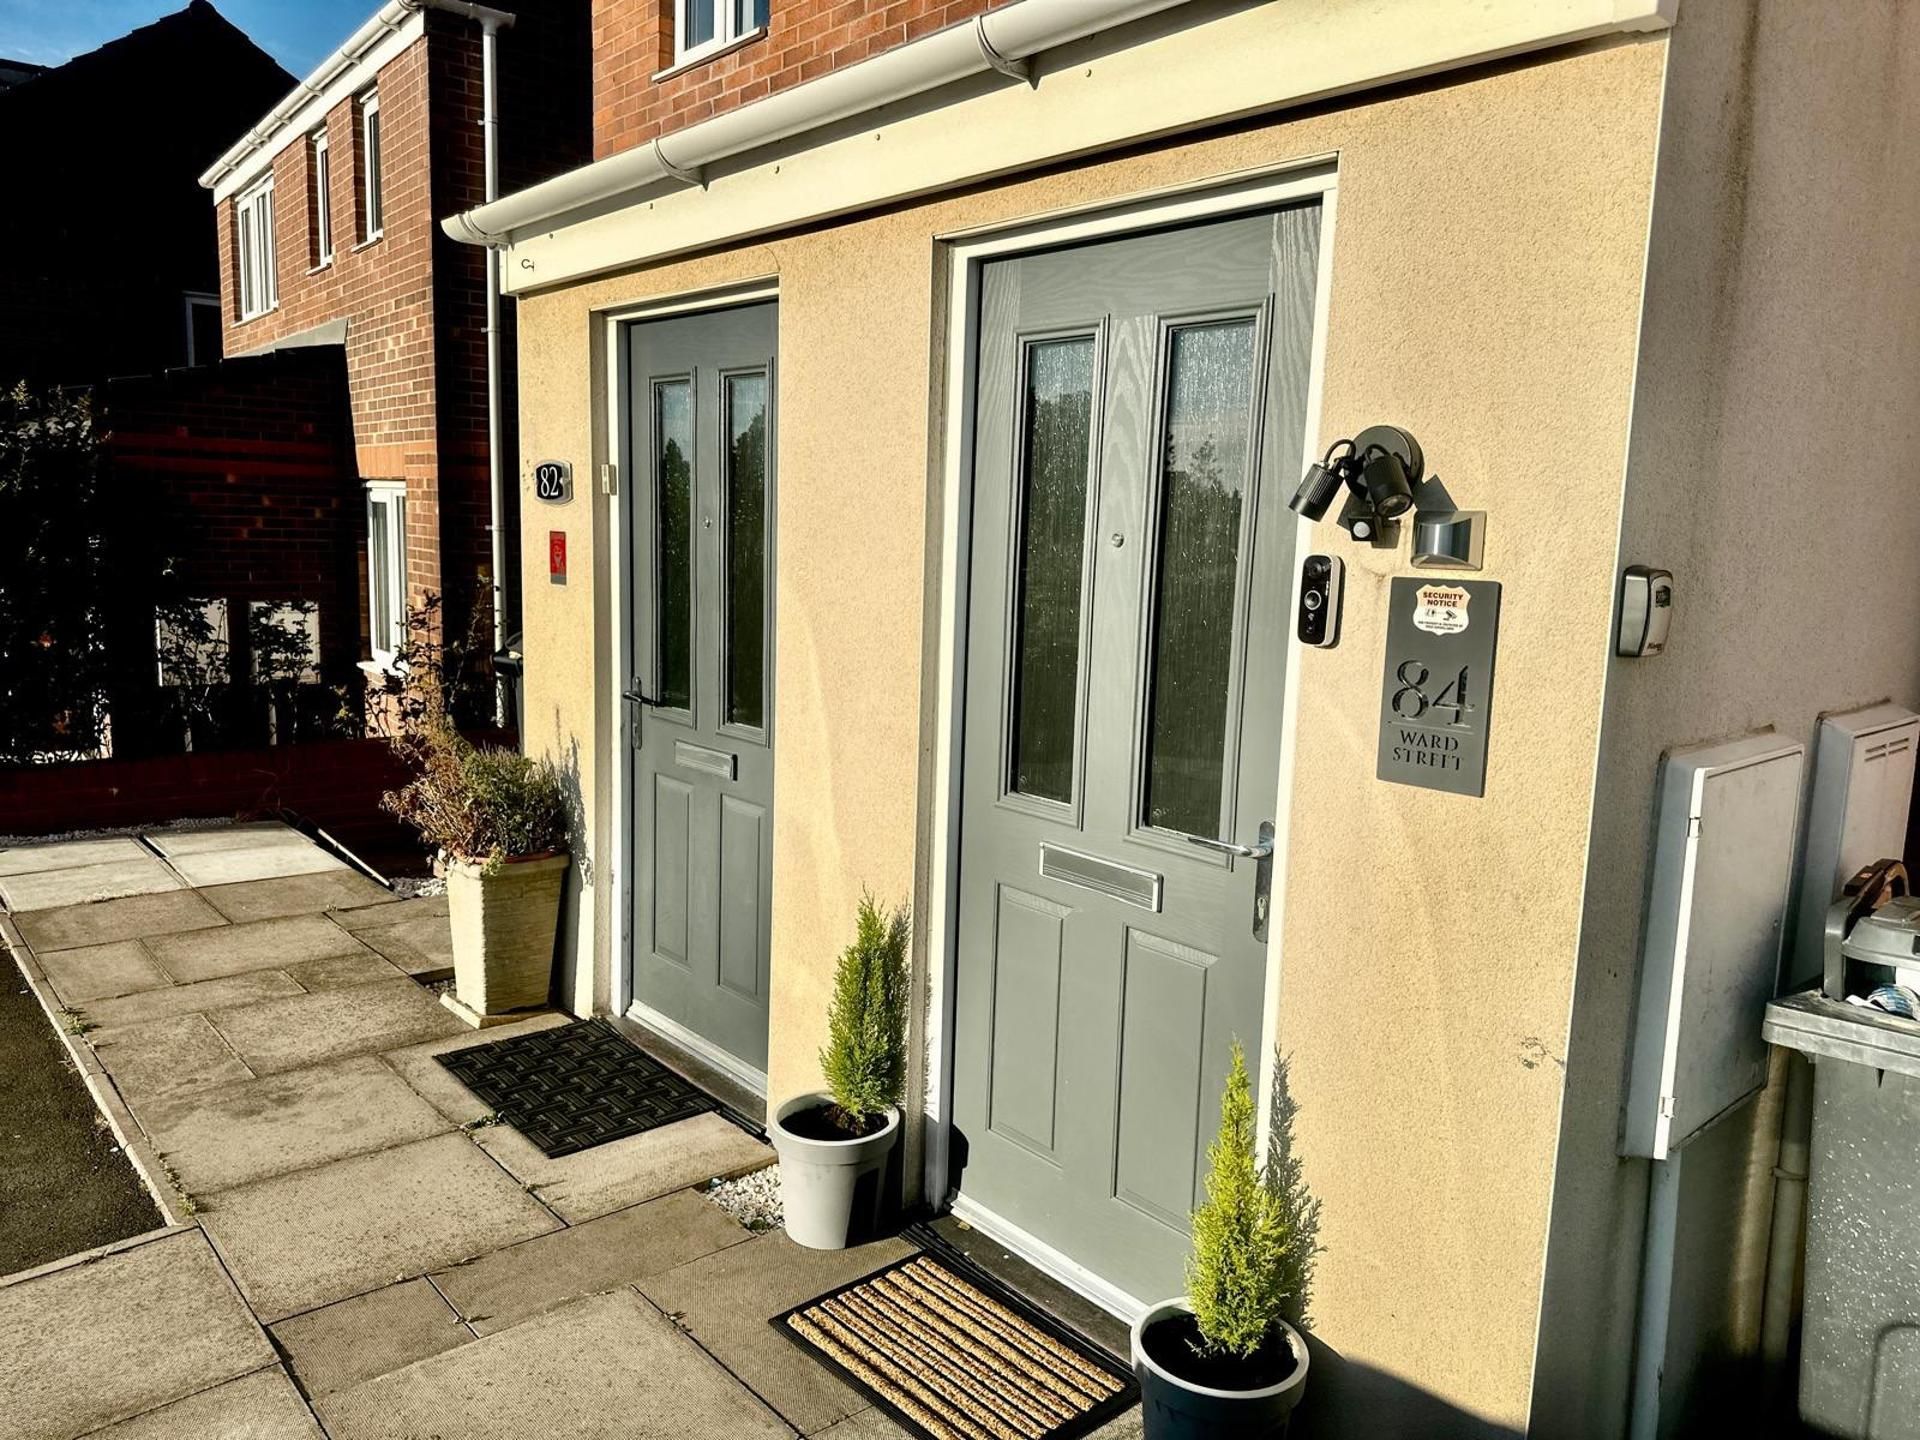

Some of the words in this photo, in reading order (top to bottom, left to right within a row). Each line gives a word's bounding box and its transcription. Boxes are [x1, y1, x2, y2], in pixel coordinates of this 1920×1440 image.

[540, 466, 558, 496] 82
[1423, 592, 1463, 600] SECURITY
[1427, 599, 1458, 607] NOTICE
[1392, 660, 1475, 728] 84
[1400, 730, 1459, 751] WARD
[1393, 747, 1463, 771] STREET
